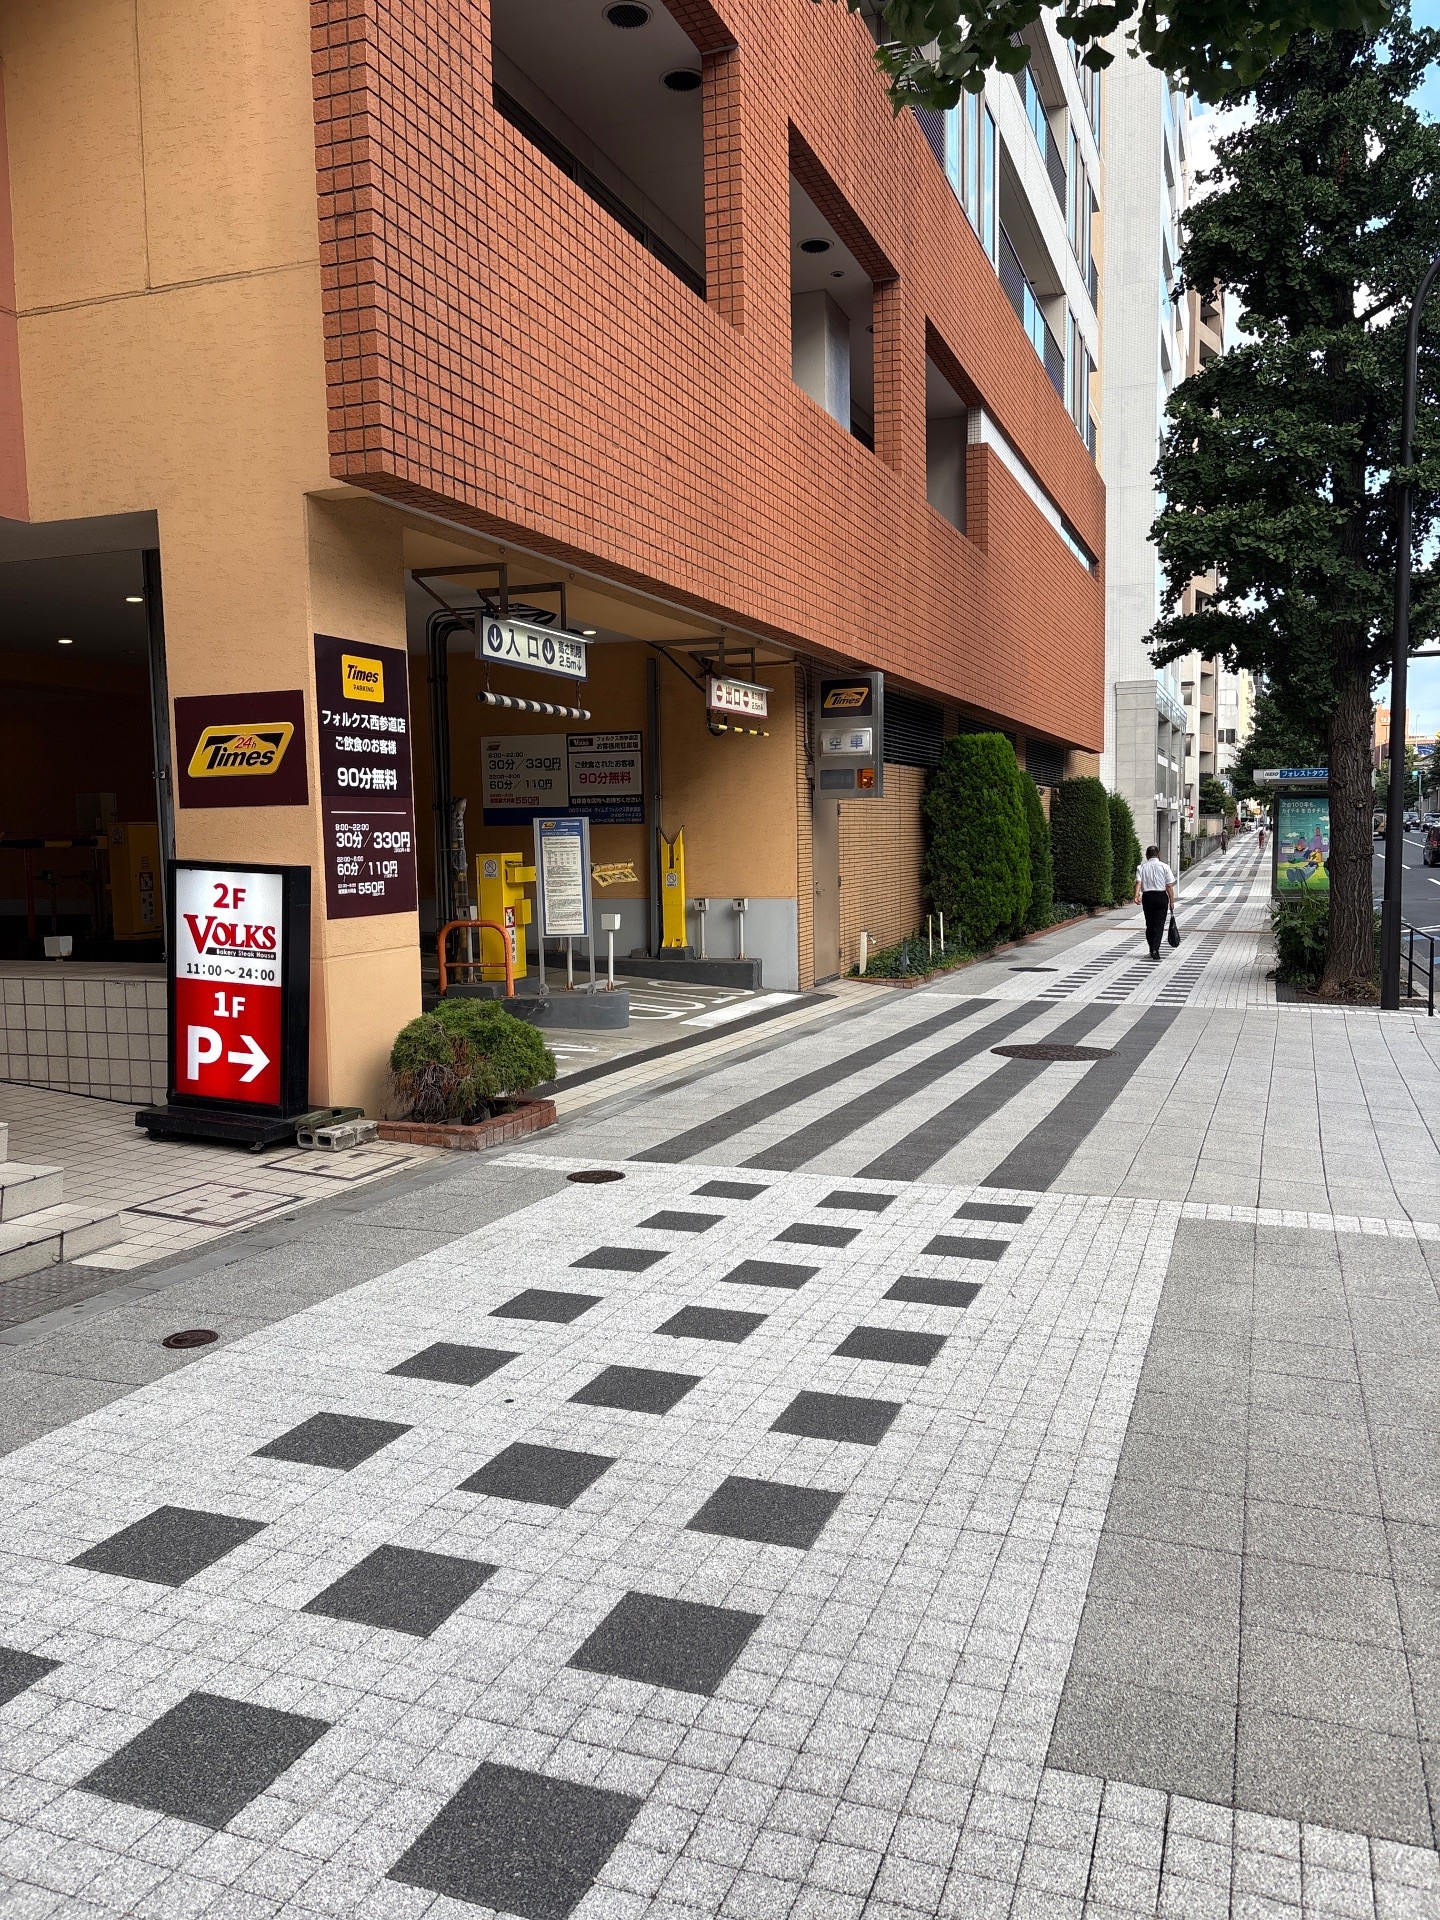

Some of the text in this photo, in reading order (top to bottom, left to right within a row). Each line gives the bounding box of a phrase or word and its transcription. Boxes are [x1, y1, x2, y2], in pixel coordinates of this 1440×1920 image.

[506, 628, 539, 660] 入口
[558, 641, 582, 658] 高さ制限
[347, 664, 380, 683] Times
[353, 684, 374, 692] PARKING
[726, 685, 740, 706] 出口
[832, 697, 860, 705] Times
[321, 709, 406, 733] フォルクス西参道店
[234, 737, 257, 749] 24h
[335, 735, 397, 755] ご飲食のお客様
[206, 746, 276, 770] Times
[337, 767, 398, 790] 90分無料
[579, 771, 631, 785] 90分無料
[213, 883, 247, 909] 2F
[358, 881, 385, 894] 550円
[183, 913, 276, 954] VOLKS
[216, 949, 236, 957] Bakery
[213, 991, 246, 1018] 1F
[186, 1024, 223, 1081] P
